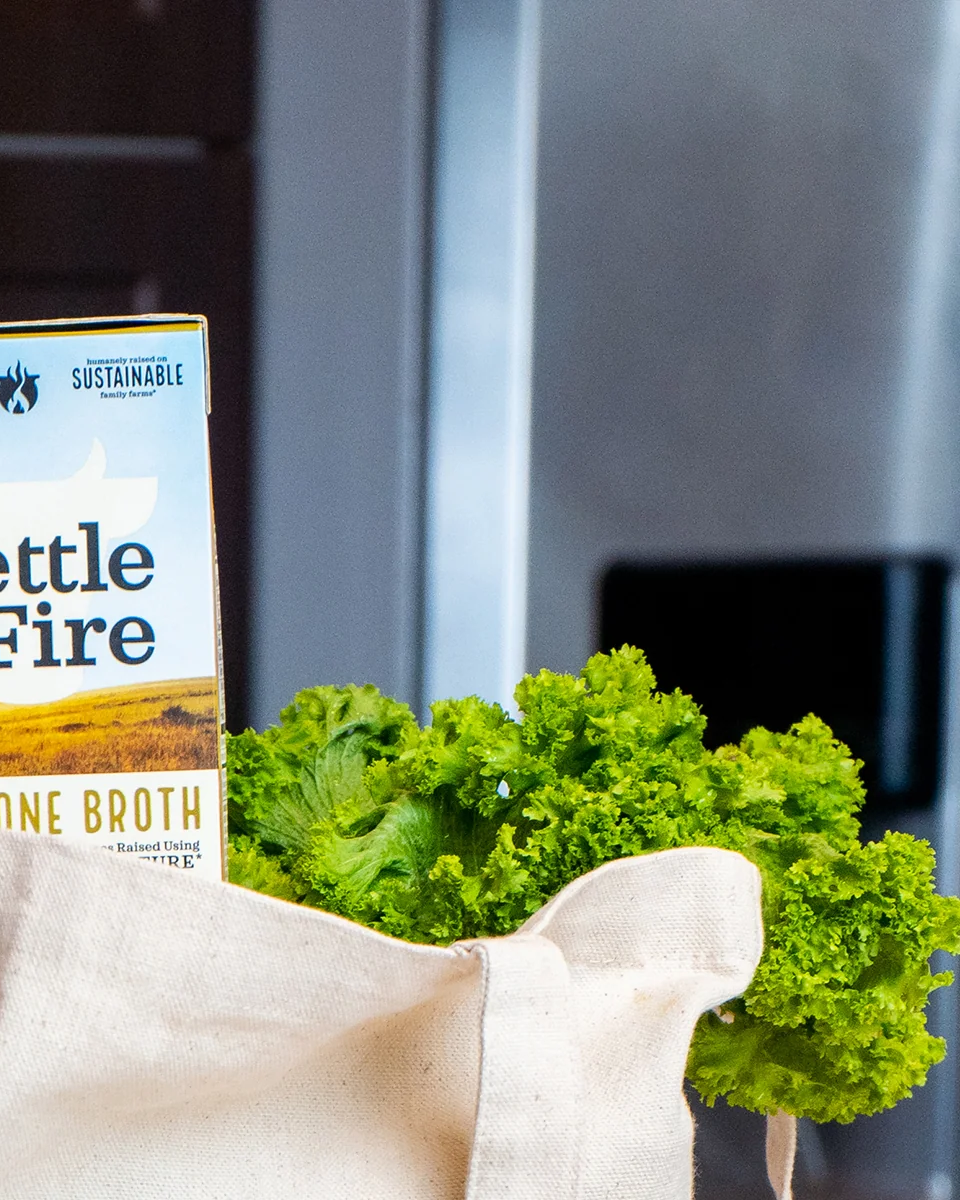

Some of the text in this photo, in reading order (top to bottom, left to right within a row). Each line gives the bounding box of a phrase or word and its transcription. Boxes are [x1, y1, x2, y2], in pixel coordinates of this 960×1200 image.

[129, 356, 155, 364] raised
[71, 363, 184, 390] SUSTAINABLE
[100, 391, 127, 399] family
[83, 785, 202, 834] BROTH
[117, 841, 161, 853] Raised
[163, 840, 200, 852] Using
